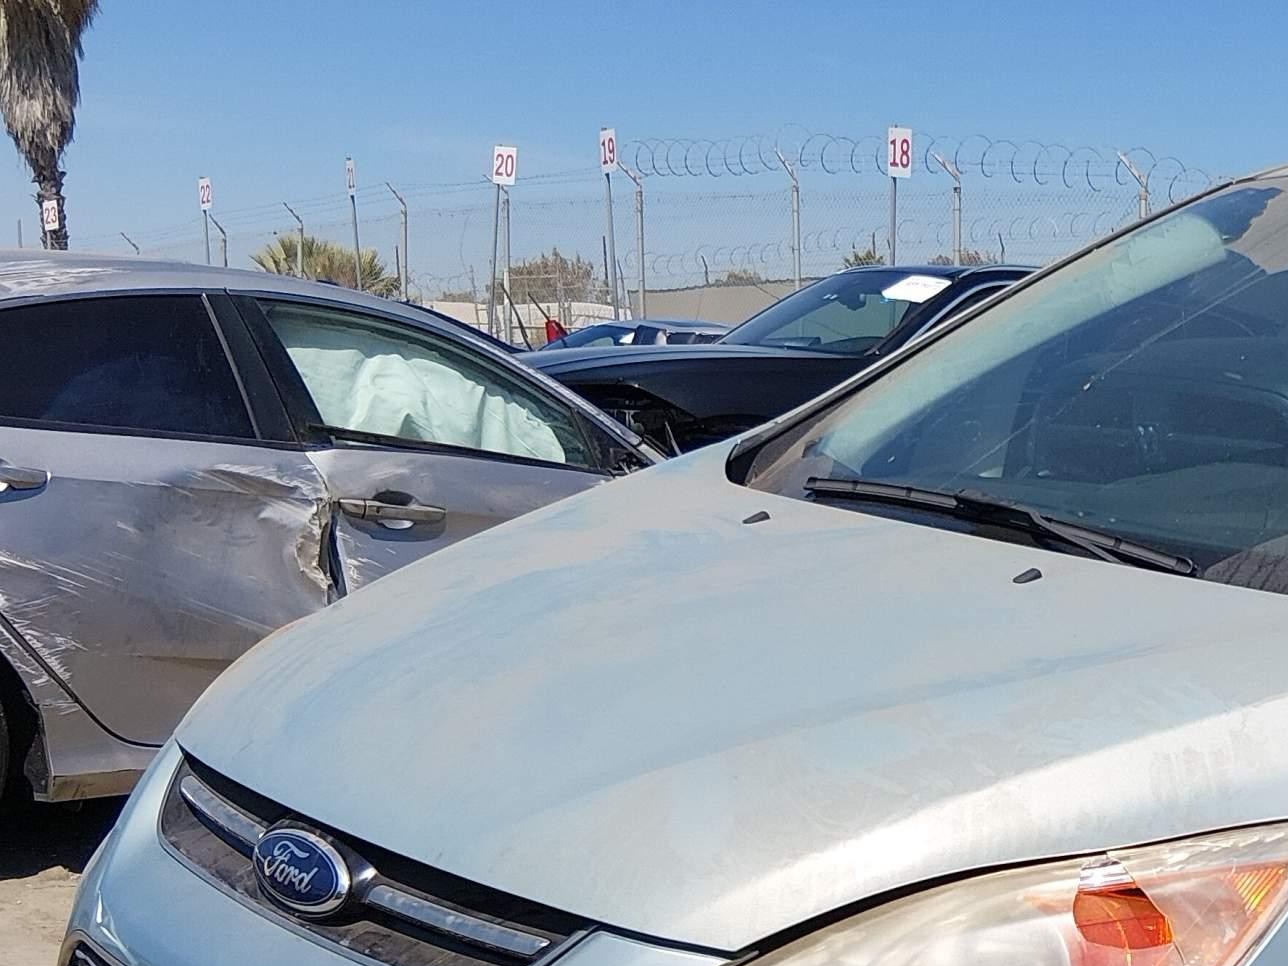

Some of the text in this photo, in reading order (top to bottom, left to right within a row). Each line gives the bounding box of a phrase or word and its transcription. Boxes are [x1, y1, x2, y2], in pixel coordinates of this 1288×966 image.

[601, 137, 615, 165] 19
[890, 138, 910, 168] 18
[494, 153, 515, 177] 20
[200, 184, 211, 204] 22
[44, 206, 57, 224] 23
[264, 840, 319, 894] Ford
